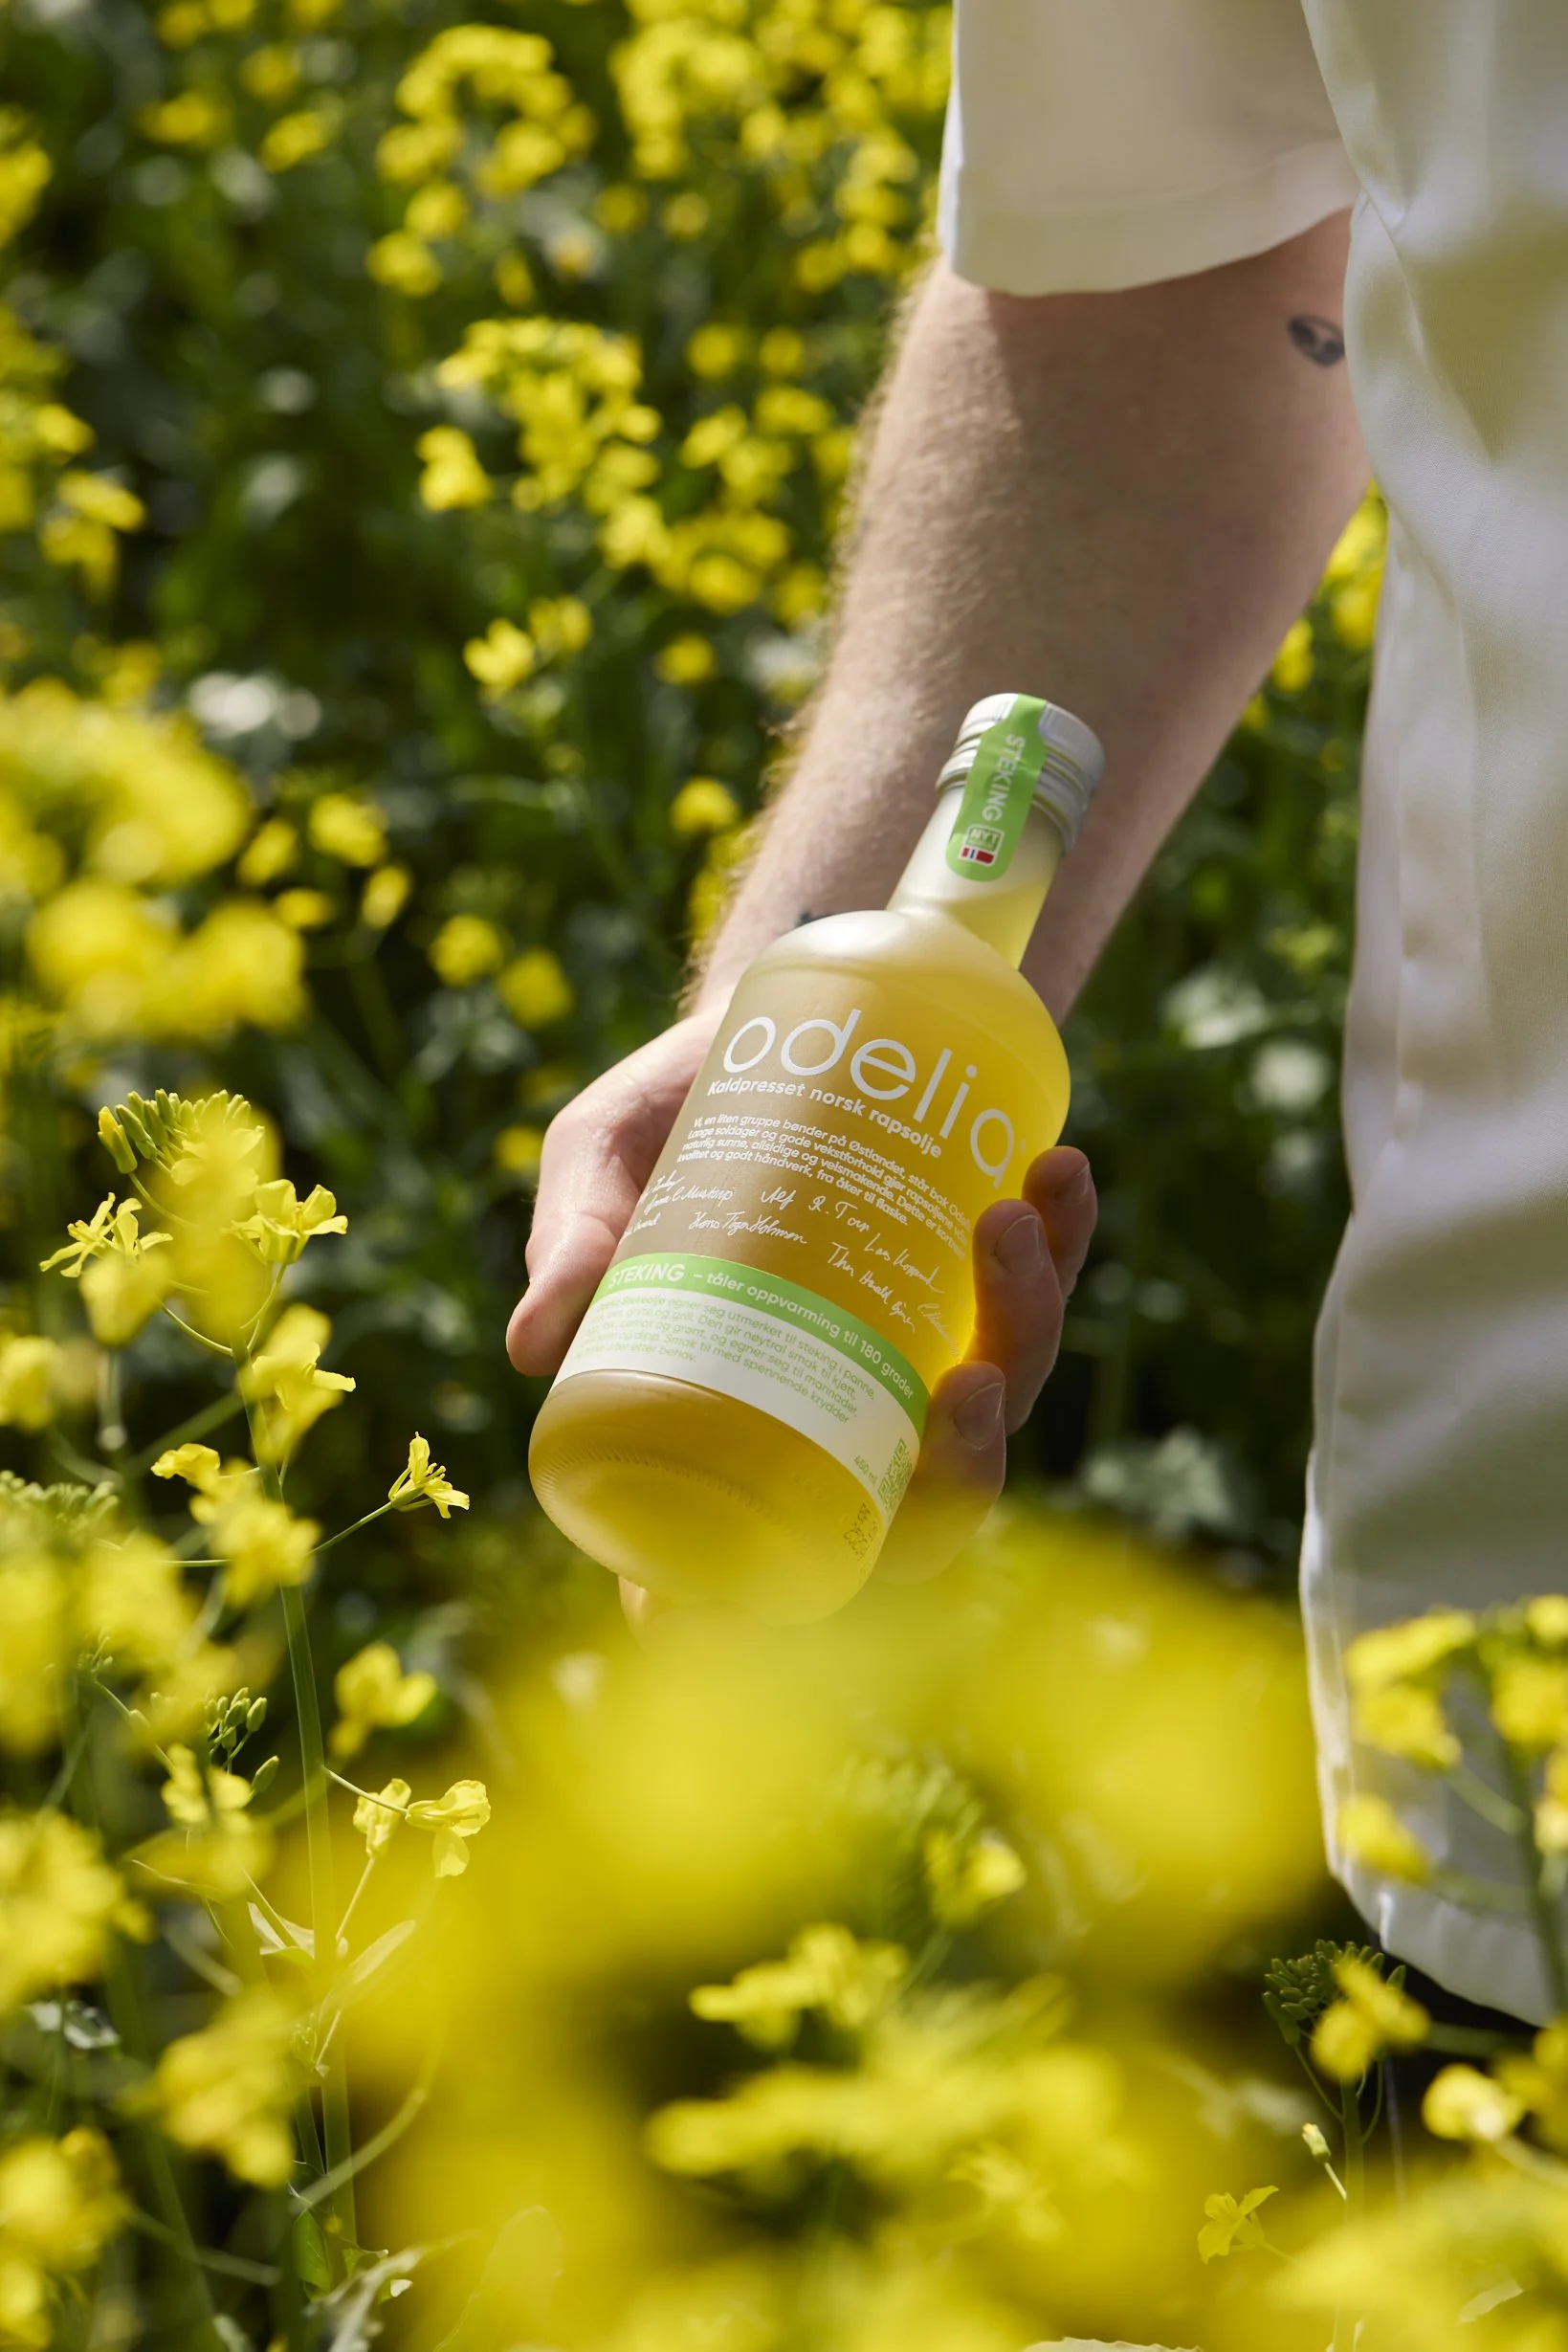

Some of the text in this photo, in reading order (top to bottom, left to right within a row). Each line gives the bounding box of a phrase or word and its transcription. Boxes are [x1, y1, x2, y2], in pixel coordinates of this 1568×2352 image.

[983, 733, 1026, 822] STEKING
[704, 1115, 717, 1125] en
[718, 1113, 740, 1124] liten
[740, 1115, 781, 1127] gruppe
[783, 1119, 828, 1140] bønder
[828, 1134, 848, 1147] på
[849, 1141, 907, 1180] Østlandet,
[908, 1174, 931, 1193] står
[929, 1187, 950, 1209] bak
[707, 1077, 942, 1159] Kaldpresset norsk rapsolje
[677, 1149, 909, 1227] kvalitet og godt håndverk, fra åker til flaske.
[682, 1138, 716, 1151] naturlig
[717, 1138, 749, 1149] sunne,
[751, 1139, 799, 1159] allsidige
[801, 1152, 819, 1165] og
[821, 1158, 895, 1202] velsmakende.
[896, 1195, 926, 1222] Dette
[925, 1218, 938, 1231] er
[688, 1126, 715, 1141] Lange
[715, 1124, 762, 1139] soldager
[762, 1130, 778, 1143] og
[779, 1133, 811, 1148] gode
[814, 1143, 885, 1179] vekstforhold
[883, 1174, 907, 1192] gjør
[906, 1187, 955, 1231] rapsoljene
[607, 1263, 686, 1289] STEKING
[707, 1271, 745, 1293] tåler
[746, 1284, 841, 1339] oppvarming
[843, 1326, 859, 1347] til
[860, 1340, 883, 1365] 180
[881, 1361, 915, 1399] grader
[654, 1320, 671, 1332] og
[710, 1333, 728, 1346] og
[729, 1340, 767, 1361] egner
[767, 1354, 791, 1373] seg
[791, 1365, 804, 1379] til
[654, 1309, 670, 1320] og
[697, 1314, 723, 1330] Den
[725, 1323, 742, 1336] gir
[743, 1330, 786, 1355] nøytral
[787, 1350, 817, 1372] smak
[820, 1366, 832, 1381] til
[831, 1372, 857, 1402] kjøtt,
[668, 1298, 701, 1310] egner
[703, 1304, 726, 1320] seg
[727, 1310, 784, 1339] utmerket
[784, 1331, 798, 1344] til
[797, 1337, 838, 1369] steking
[842, 1368, 875, 1401] panne,
[663, 1333, 698, 1348] Smak
[699, 1342, 712, 1352] til
[713, 1346, 742, 1363] med
[742, 1356, 809, 1397] spennende
[809, 1388, 850, 1425] krydder
[853, 1454, 870, 1475] 450
